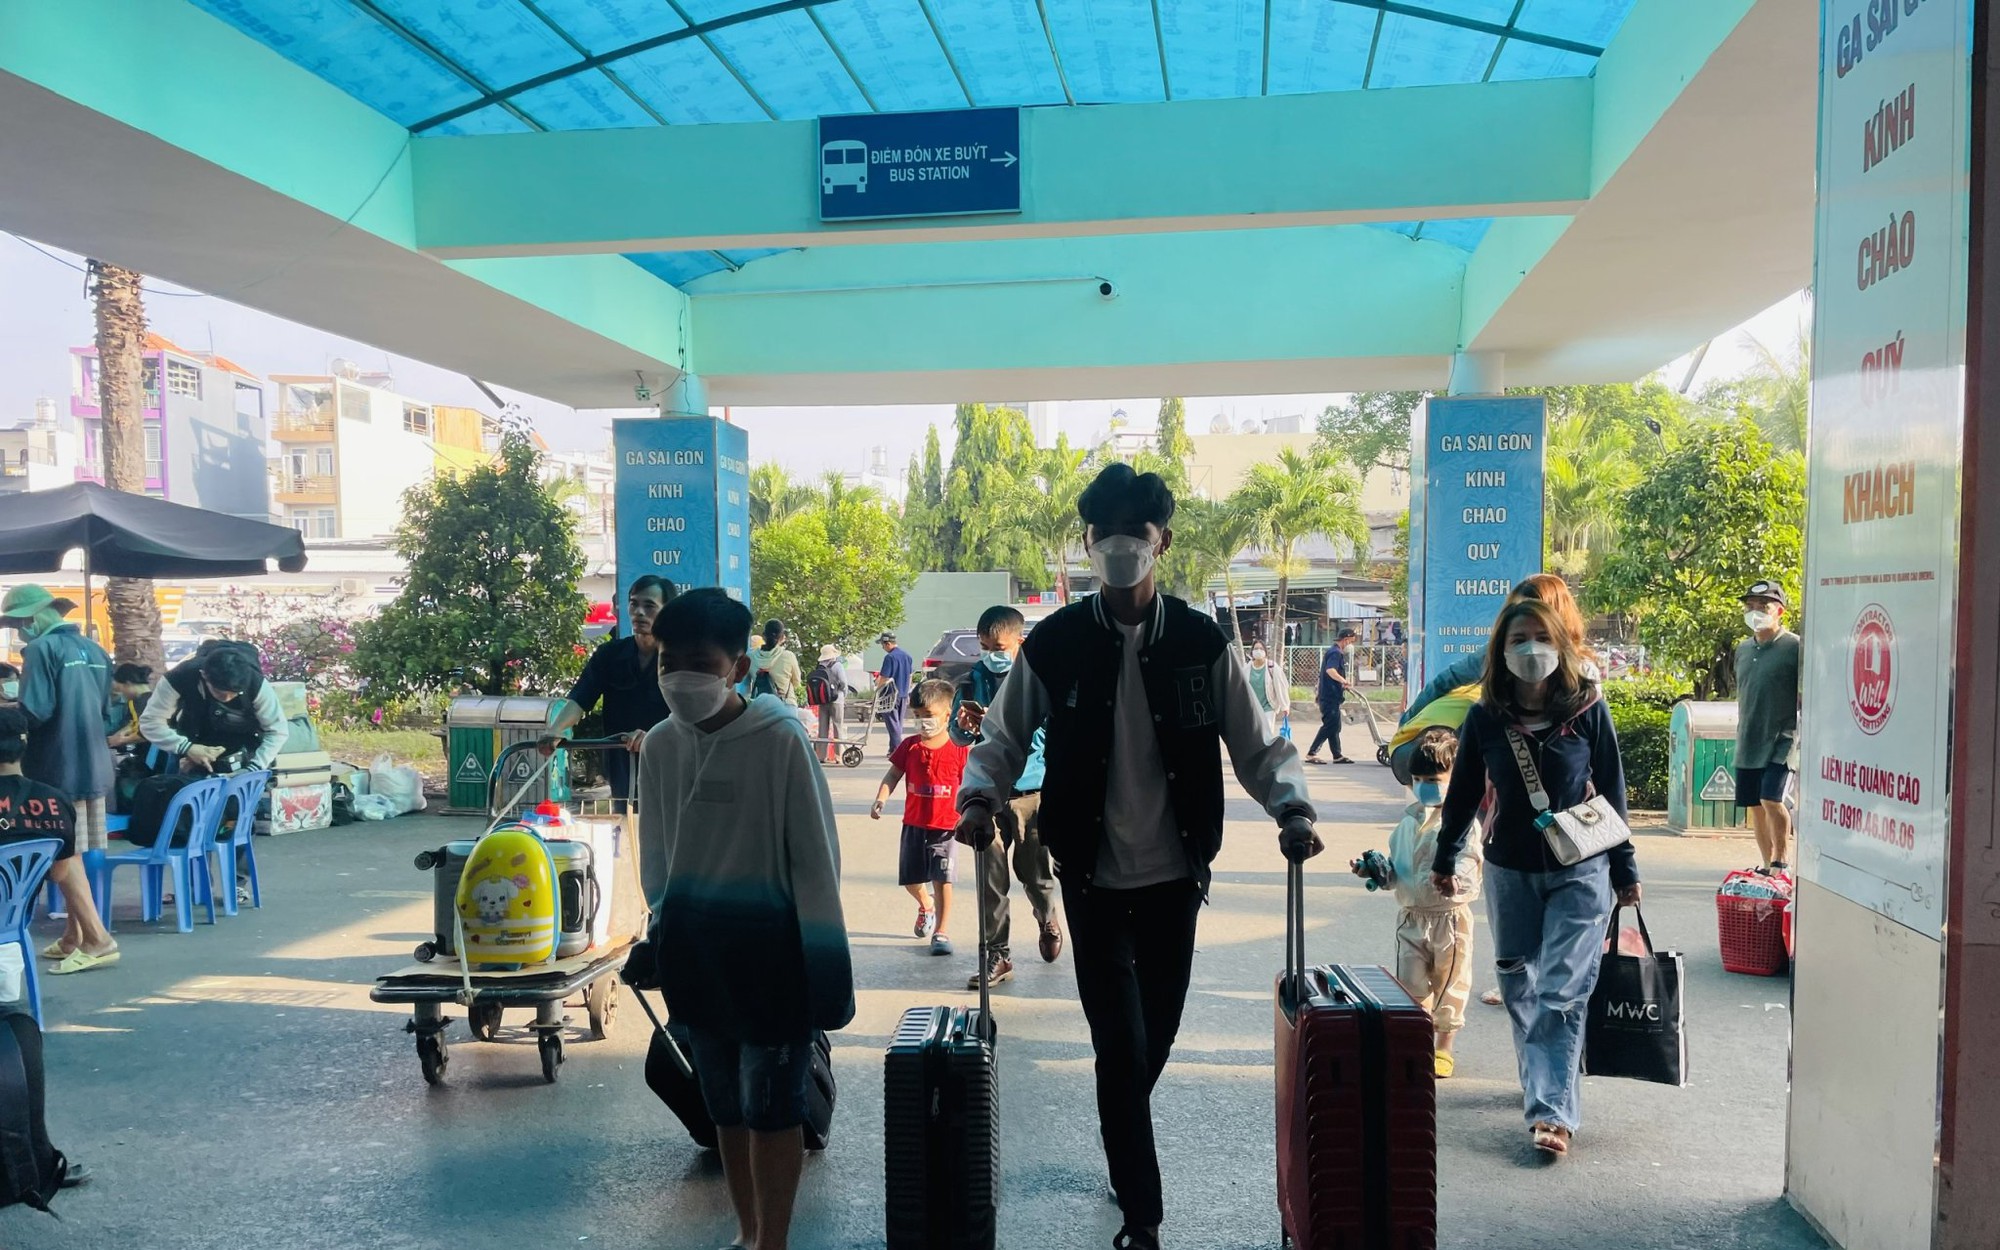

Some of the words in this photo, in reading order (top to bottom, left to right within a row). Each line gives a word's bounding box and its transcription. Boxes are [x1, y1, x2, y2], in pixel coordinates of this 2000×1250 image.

[1837, 13, 1863, 78] GA
[1863, 82, 1915, 173] KÍNH
[935, 147, 952, 161] XE
[954, 142, 988, 160] BUÝT
[889, 168, 915, 182] BUS
[918, 165, 970, 181] STATION
[1857, 210, 1915, 291] CHÀO
[1861, 329, 1905, 408] QUÝ
[626, 450, 645, 466] GA
[1441, 435, 1463, 452] GA
[1462, 504, 1507, 524] CHÀO
[1851, 700, 1891, 730] ADVERTISING
[1897, 772, 1920, 806] CÁO
[1839, 803, 1915, 850] 0918.46.06.06
[1607, 1001, 1660, 1021] MWC
